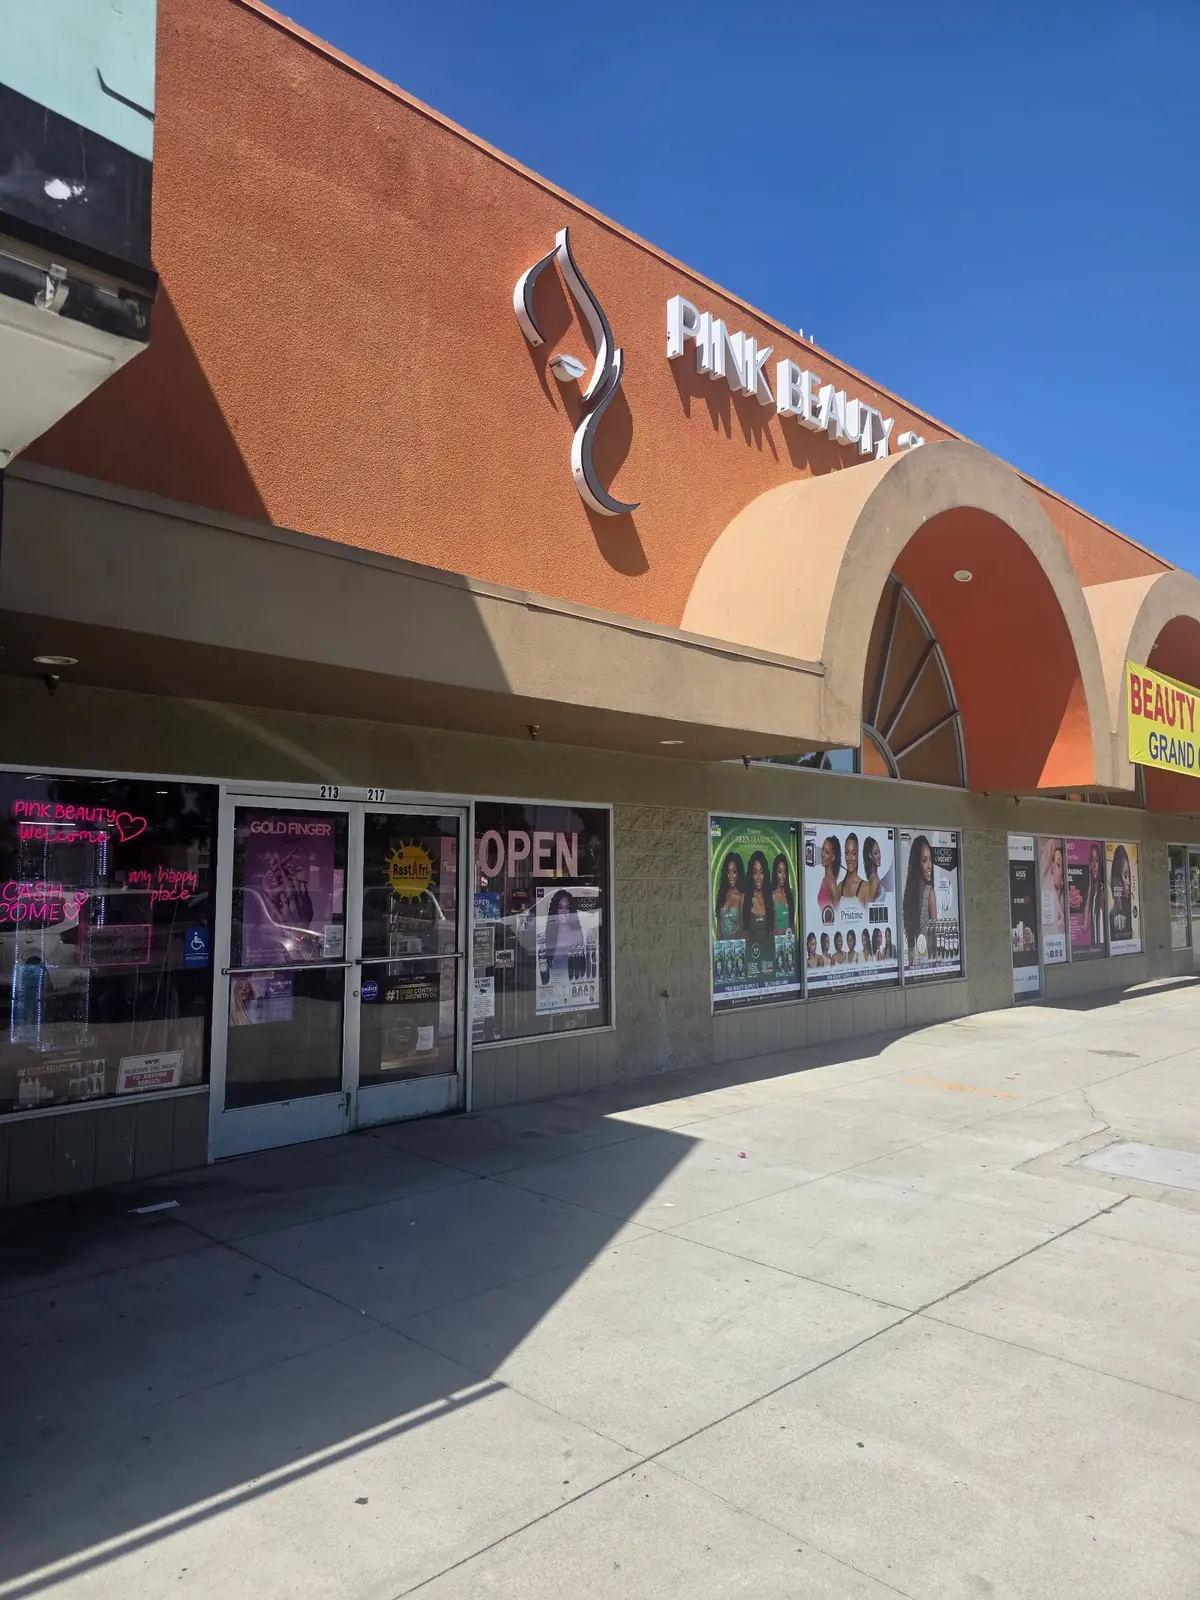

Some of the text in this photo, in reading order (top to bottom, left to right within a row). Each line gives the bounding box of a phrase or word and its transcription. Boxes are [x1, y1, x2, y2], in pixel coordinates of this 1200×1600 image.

[667, 294, 896, 460] PINK BEAUTY
[1130, 673, 1195, 733] BEAUTY
[1148, 731, 1195, 769] GRAND
[320, 786, 339, 799] 213
[368, 788, 385, 801] 217
[250, 820, 332, 836] GOLD FINGER
[478, 829, 579, 878] OPEN
[128, 864, 198, 891] my happy
[3, 881, 63, 901] CASH
[150, 885, 192, 911] place
[840, 909, 865, 921] Pristine
